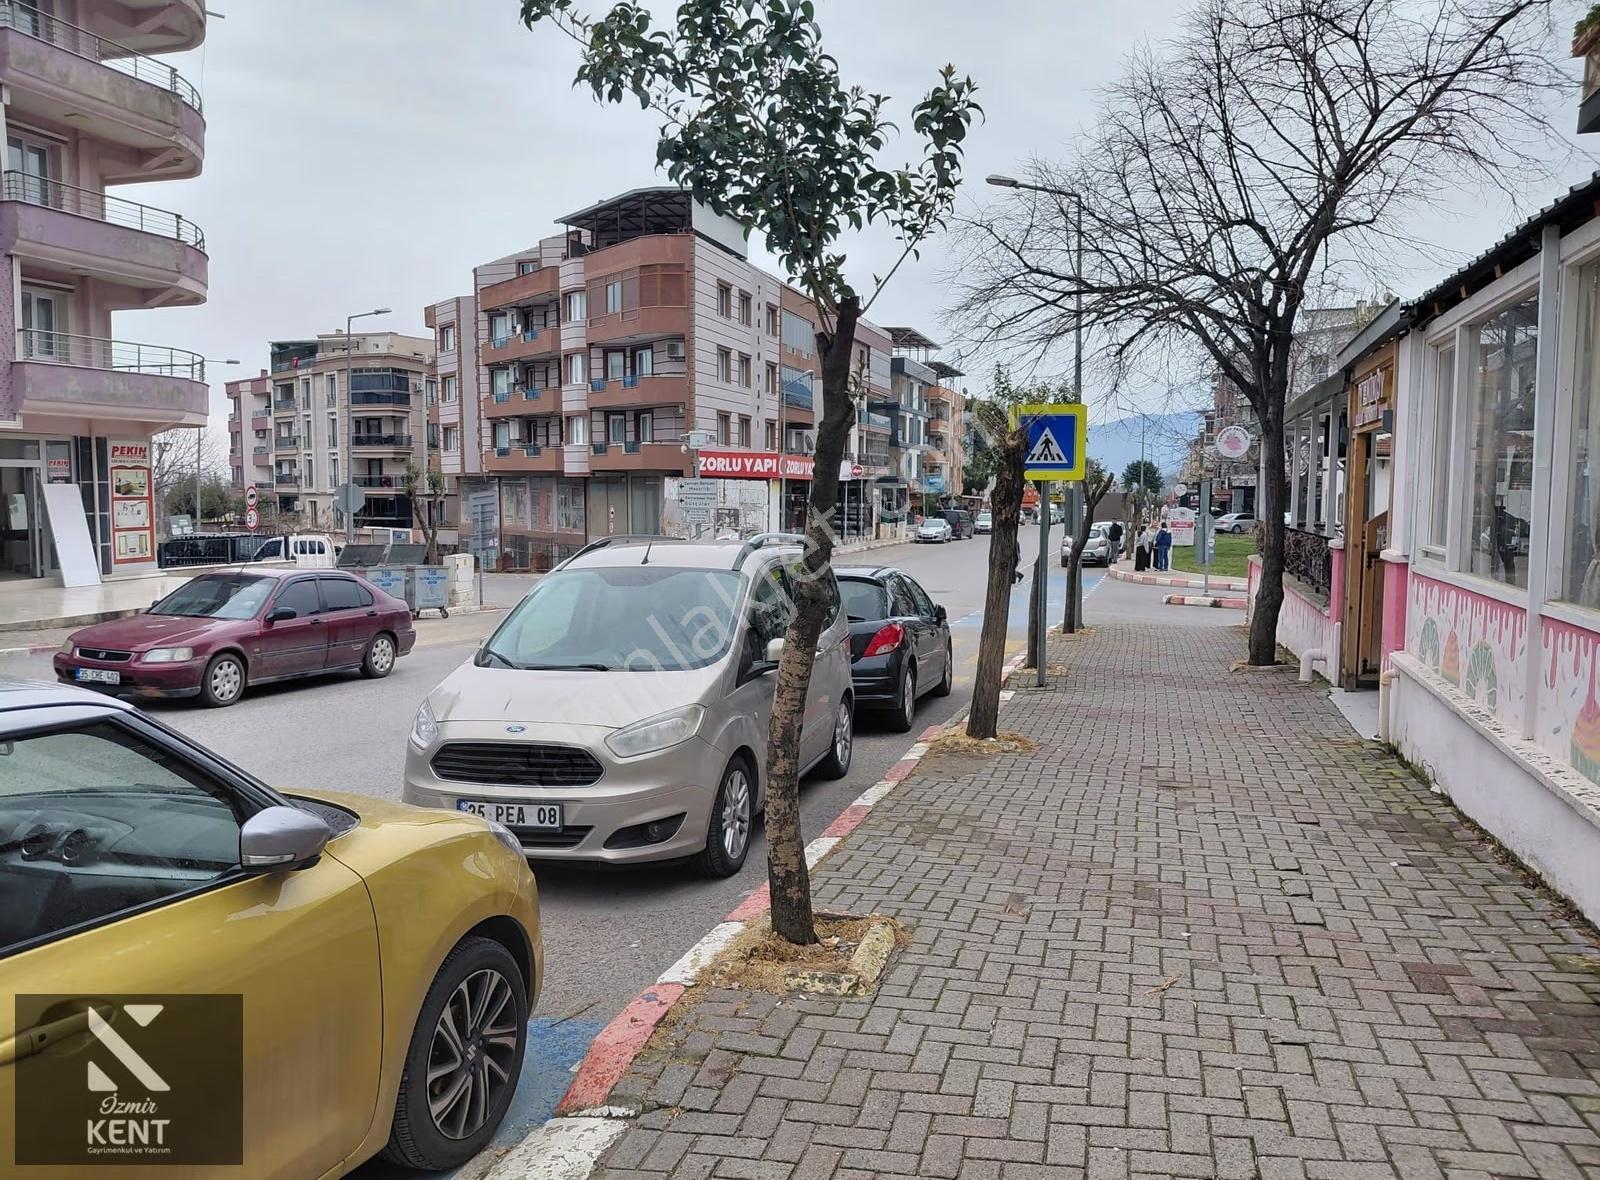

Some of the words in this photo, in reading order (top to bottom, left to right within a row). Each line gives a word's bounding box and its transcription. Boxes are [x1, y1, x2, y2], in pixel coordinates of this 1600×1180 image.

[699, 457, 742, 472] ZORLU
[743, 458, 776, 473] YAPI
[786, 461, 804, 475] ZORLU
[804, 462, 815, 476] YAP
[80, 669, 89, 679] 35
[91, 670, 104, 680] CHE
[495, 805, 526, 824] PEA
[537, 807, 557, 824] 08
